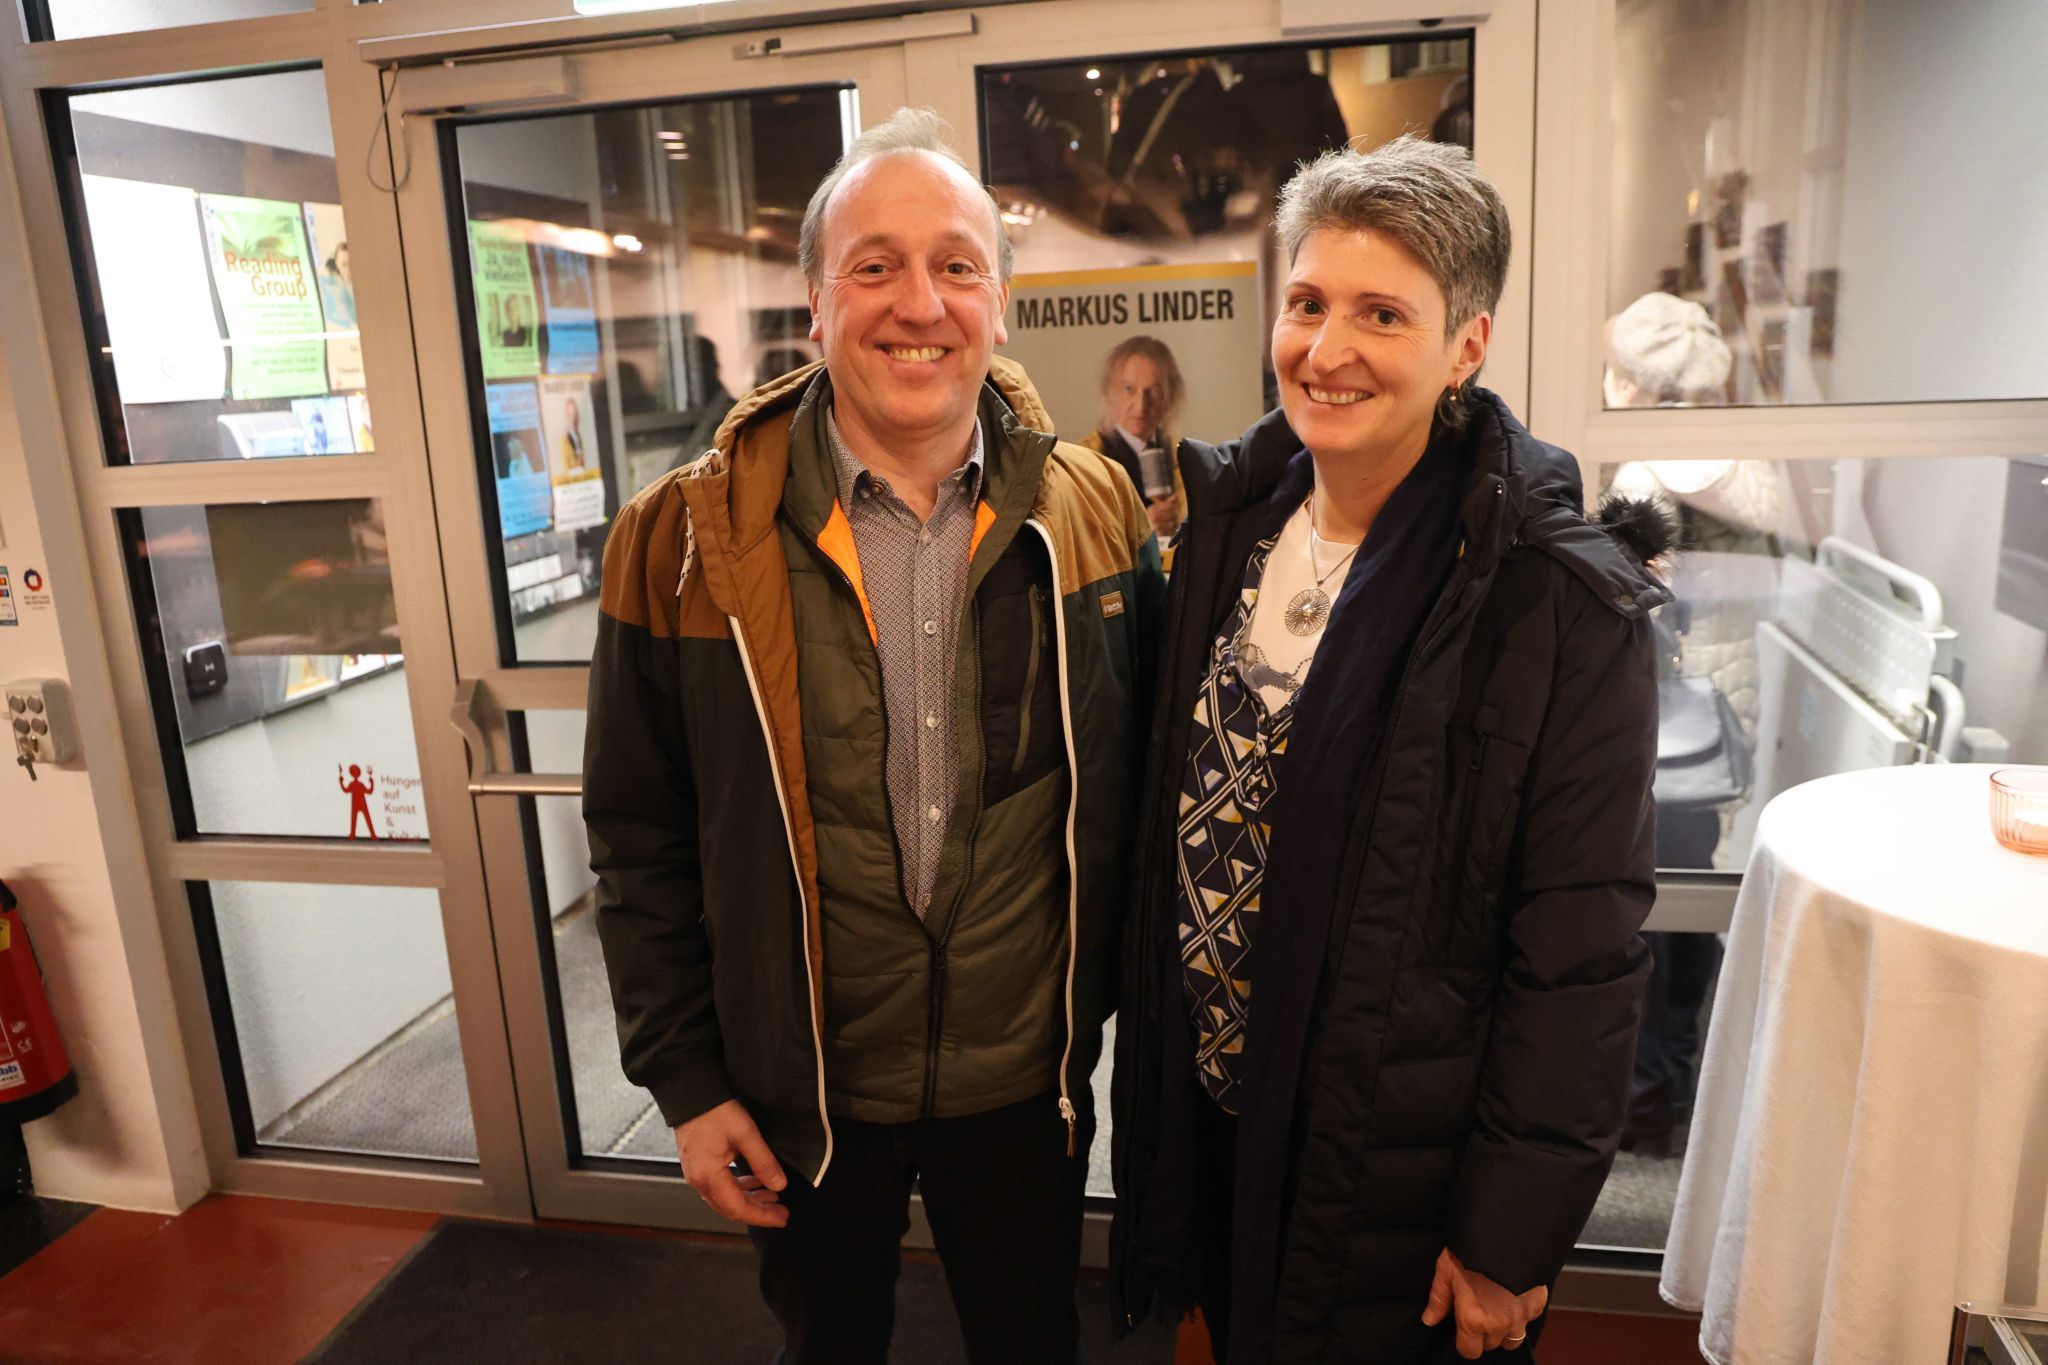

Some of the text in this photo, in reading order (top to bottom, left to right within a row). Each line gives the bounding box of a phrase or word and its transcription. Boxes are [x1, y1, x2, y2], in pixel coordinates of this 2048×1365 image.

[223, 250, 303, 281] Reading
[251, 274, 307, 301] Group
[1016, 288, 1234, 329] MARKUS LINDER
[380, 775, 421, 789] Hunger
[383, 788, 400, 800] auf
[384, 802, 416, 814] Kunst
